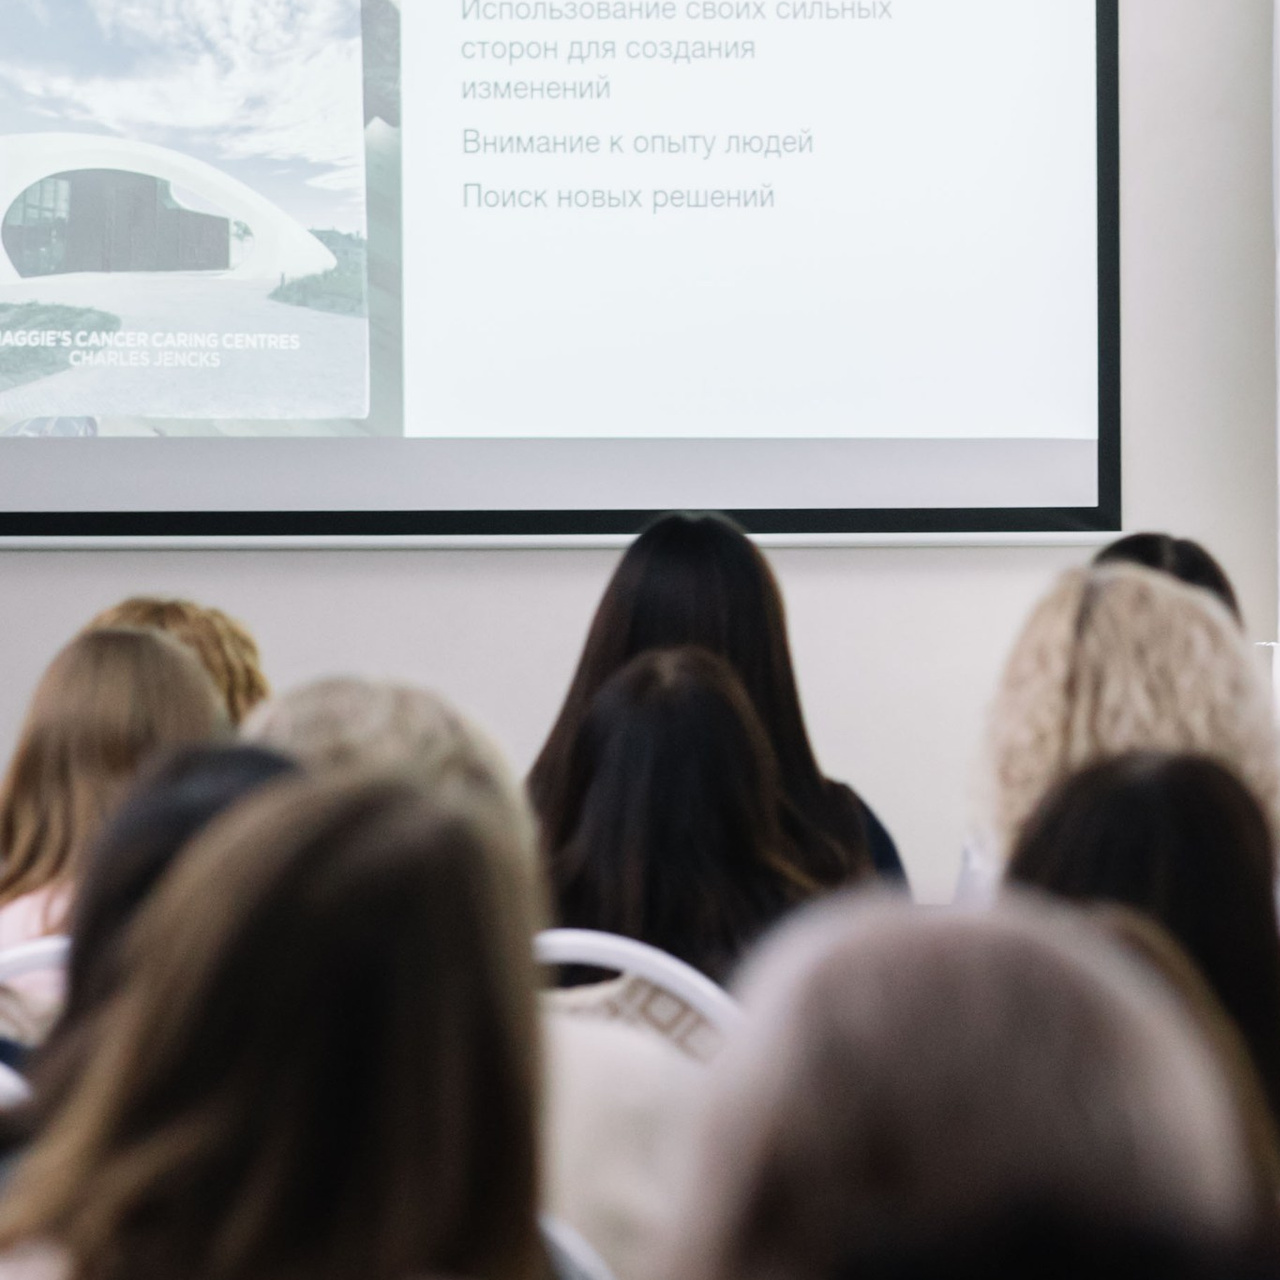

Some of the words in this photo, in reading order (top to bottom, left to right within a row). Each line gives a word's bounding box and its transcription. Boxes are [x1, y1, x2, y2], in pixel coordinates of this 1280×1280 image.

[686, 0, 766, 20] своих
[775, 0, 893, 20] сильных
[460, 40, 558, 66] сторон
[567, 40, 616, 64] для
[625, 40, 756, 64] создания
[461, 75, 611, 100] изменений
[463, 128, 600, 154] Внимание
[609, 135, 624, 154] к
[633, 134, 717, 160] опыту
[724, 128, 814, 158] людей
[463, 183, 548, 208] Поиск
[557, 189, 643, 208] новых
[652, 183, 775, 215] решений
[0, 329, 73, 348] AGGIE'S
[75, 330, 149, 348] CANCER
[151, 331, 219, 349] CARING
[221, 333, 301, 351] CENTRES
[68, 350, 150, 368] CHARLES
[152, 351, 222, 369] JENCKS
